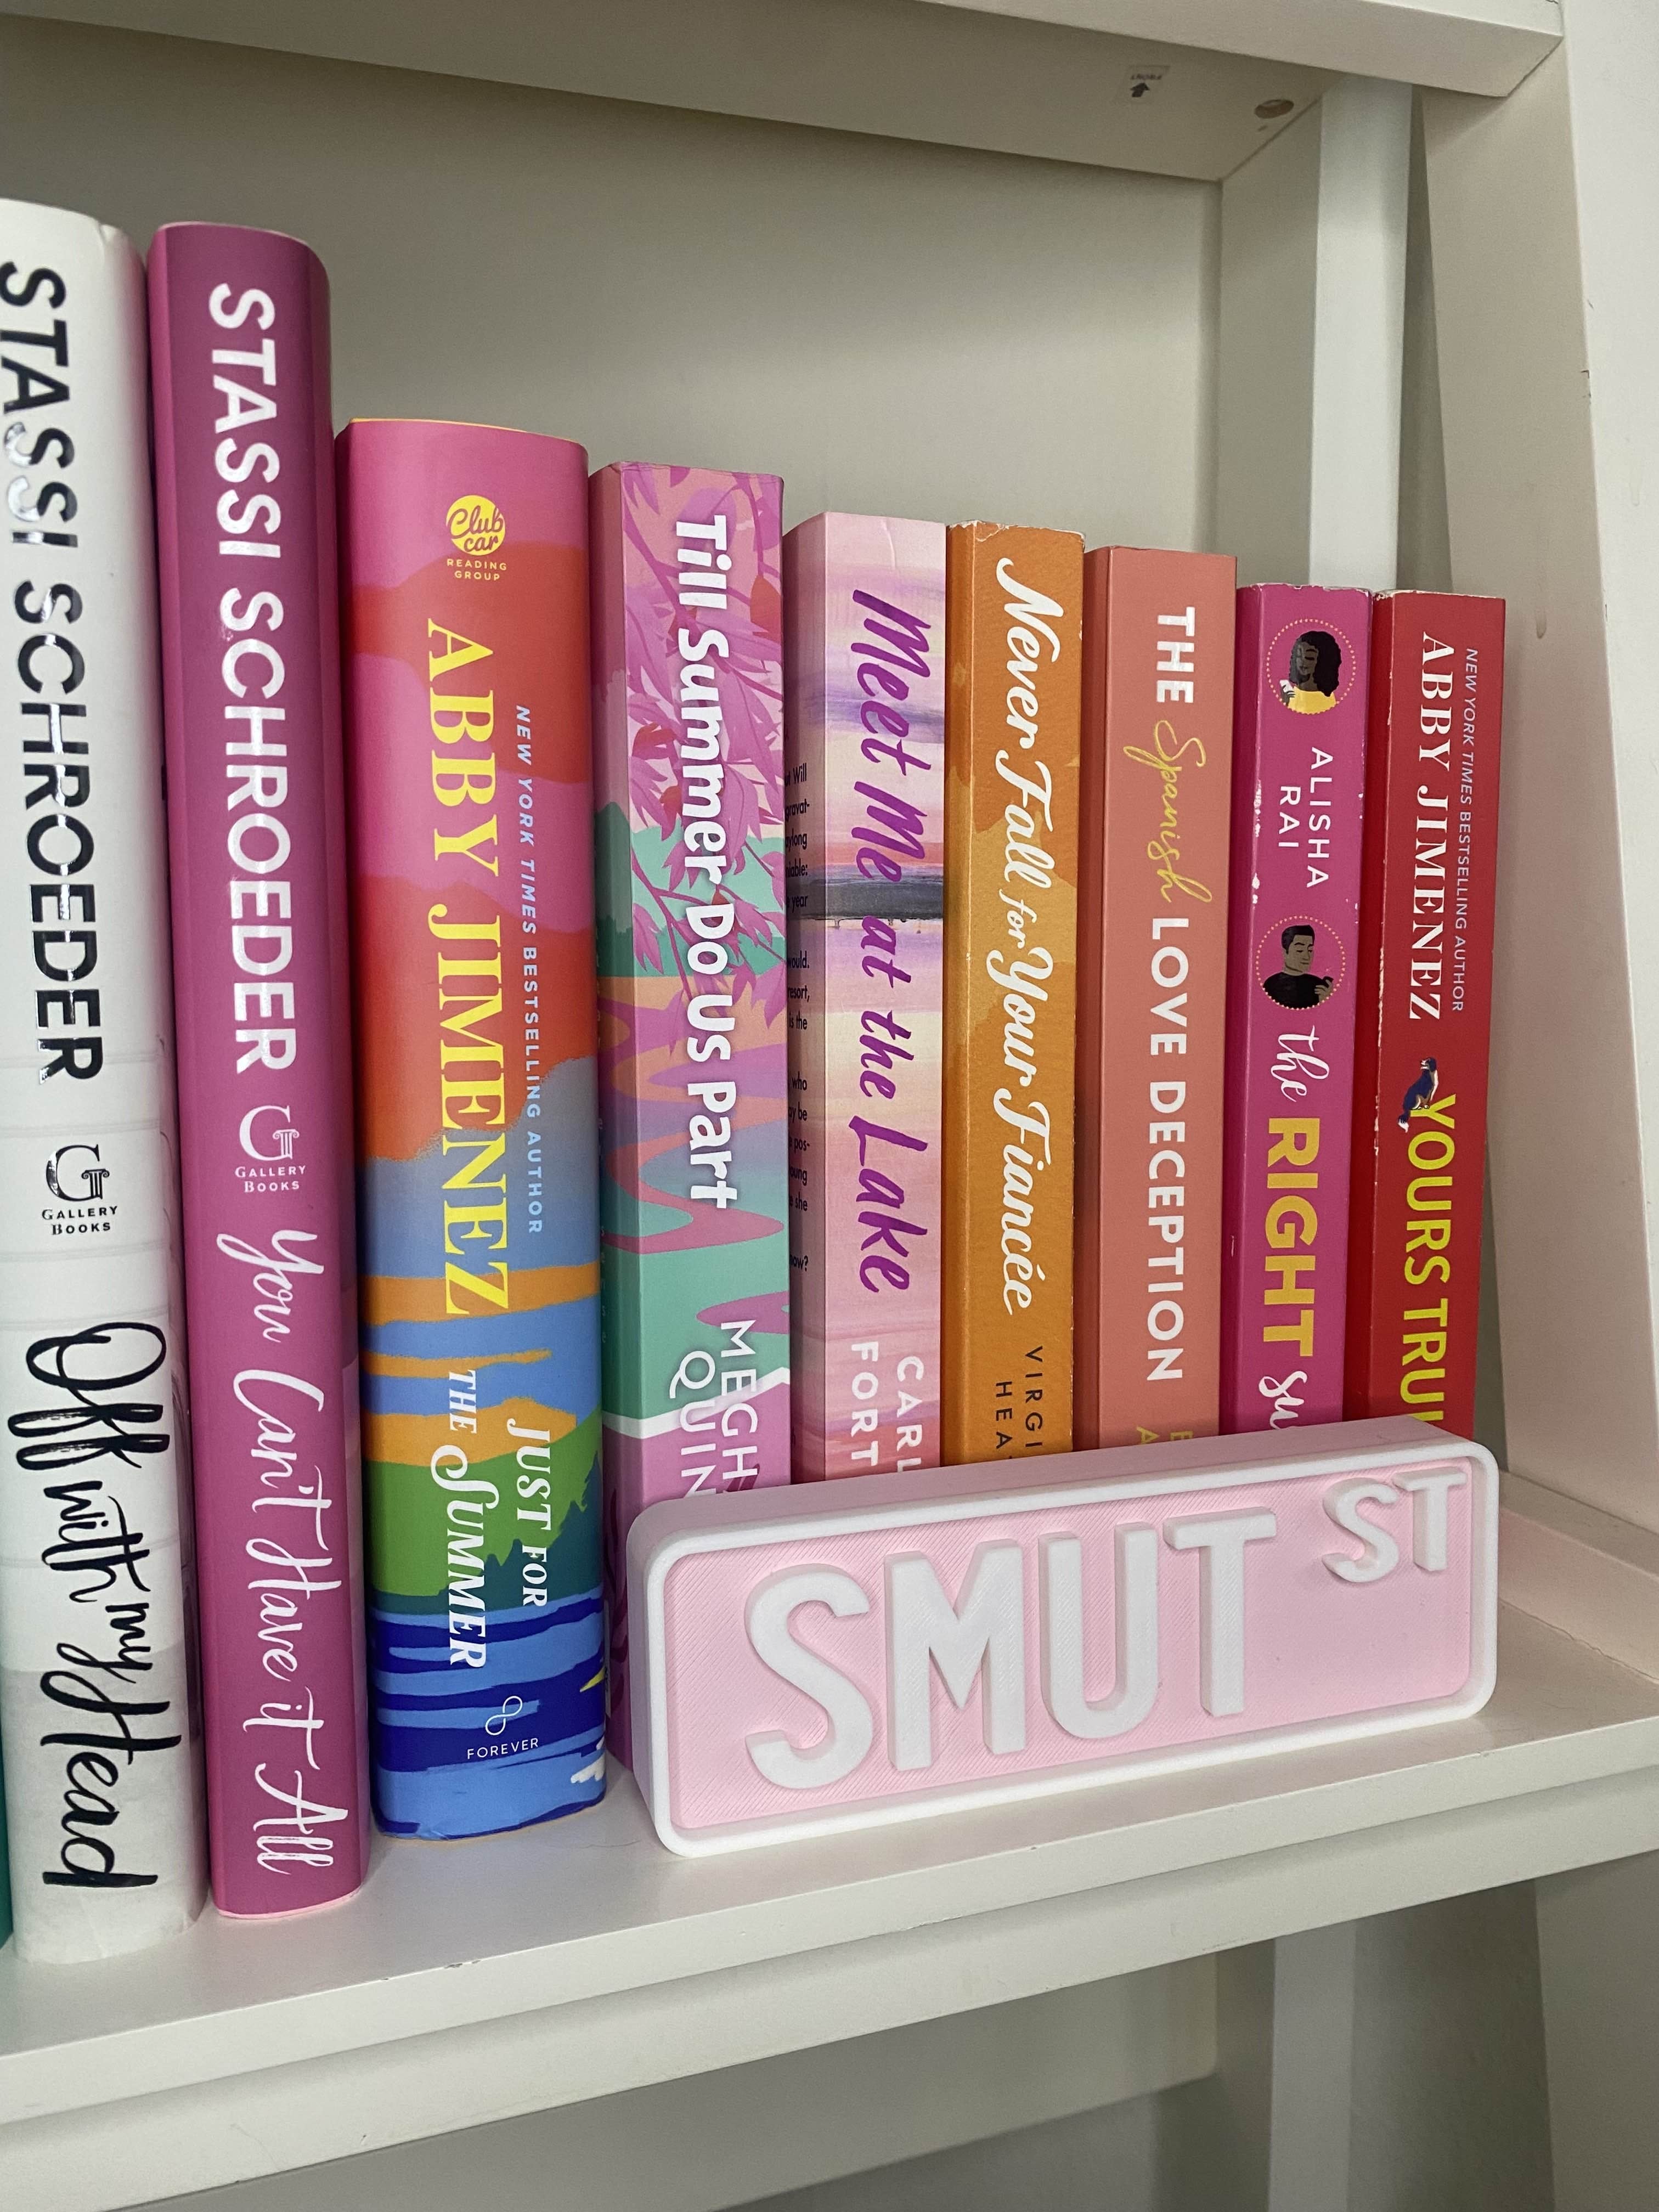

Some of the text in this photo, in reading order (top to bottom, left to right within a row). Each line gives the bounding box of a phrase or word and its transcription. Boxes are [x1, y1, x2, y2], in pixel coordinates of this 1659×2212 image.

[447, 505, 504, 539] Club
[447, 558, 507, 571] READING
[454, 570, 500, 581] GROUP
[464, 535, 499, 552] car
[675, 514, 732, 610] Till
[0, 261, 104, 1085] STASSI SCHROEDER
[208, 283, 297, 1074] STASSI SCHROEDER
[676, 628, 730, 886] Summer
[793, 763, 807, 784] Will
[1278, 785, 1302, 848] RAI
[1306, 747, 1334, 888] ALISHA
[1409, 631, 1455, 1020] ABBY JIMENEZ
[1452, 648, 1479, 1012] NEW YORK TIMES BESTSELLING AUTHOR
[685, 903, 735, 975] Do
[792, 895, 808, 913] year
[848, 589, 931, 1293] Meet Me at the Lake
[985, 557, 1064, 1316] Never Fall for Your Fiancée
[427, 617, 510, 1316] ABBY JIMENEZ
[516, 704, 543, 1235] NEW YORK TIMES BESTSELLING AUTHOR
[789, 1010, 808, 1030] is the
[1122, 606, 1213, 1381] THE Spanish LOVE DECEPTION
[792, 1070, 808, 1091] who
[798, 1101, 808, 1121] be
[1270, 1025, 1330, 1103] the
[234, 1165, 306, 1178] GALLERY
[244, 1180, 300, 1193] BOOKS
[687, 1081, 738, 1210] Part
[794, 1190, 808, 1212] she
[1404, 1093, 1457, 1285] YOURS
[42, 1205, 118, 1221] GALLERY
[52, 1222, 111, 1235] BOOKS
[1263, 1118, 1321, 1357] RIGHT
[720, 1319, 758, 1493] MEGH
[850, 1341, 879, 1466] FORT
[995, 1381, 1013, 1459] HEA
[1025, 1345, 1043, 1448] VIRGI
[217, 1229, 349, 1876] You Can't Have it All
[430, 1369, 500, 1668] THE SUMMER
[507, 1418, 551, 1608] JUST FOR
[7, 1321, 182, 1888] Off with my Head
[744, 1468, 1467, 1790] SMUT ST
[467, 1737, 539, 1760] FOREVER
